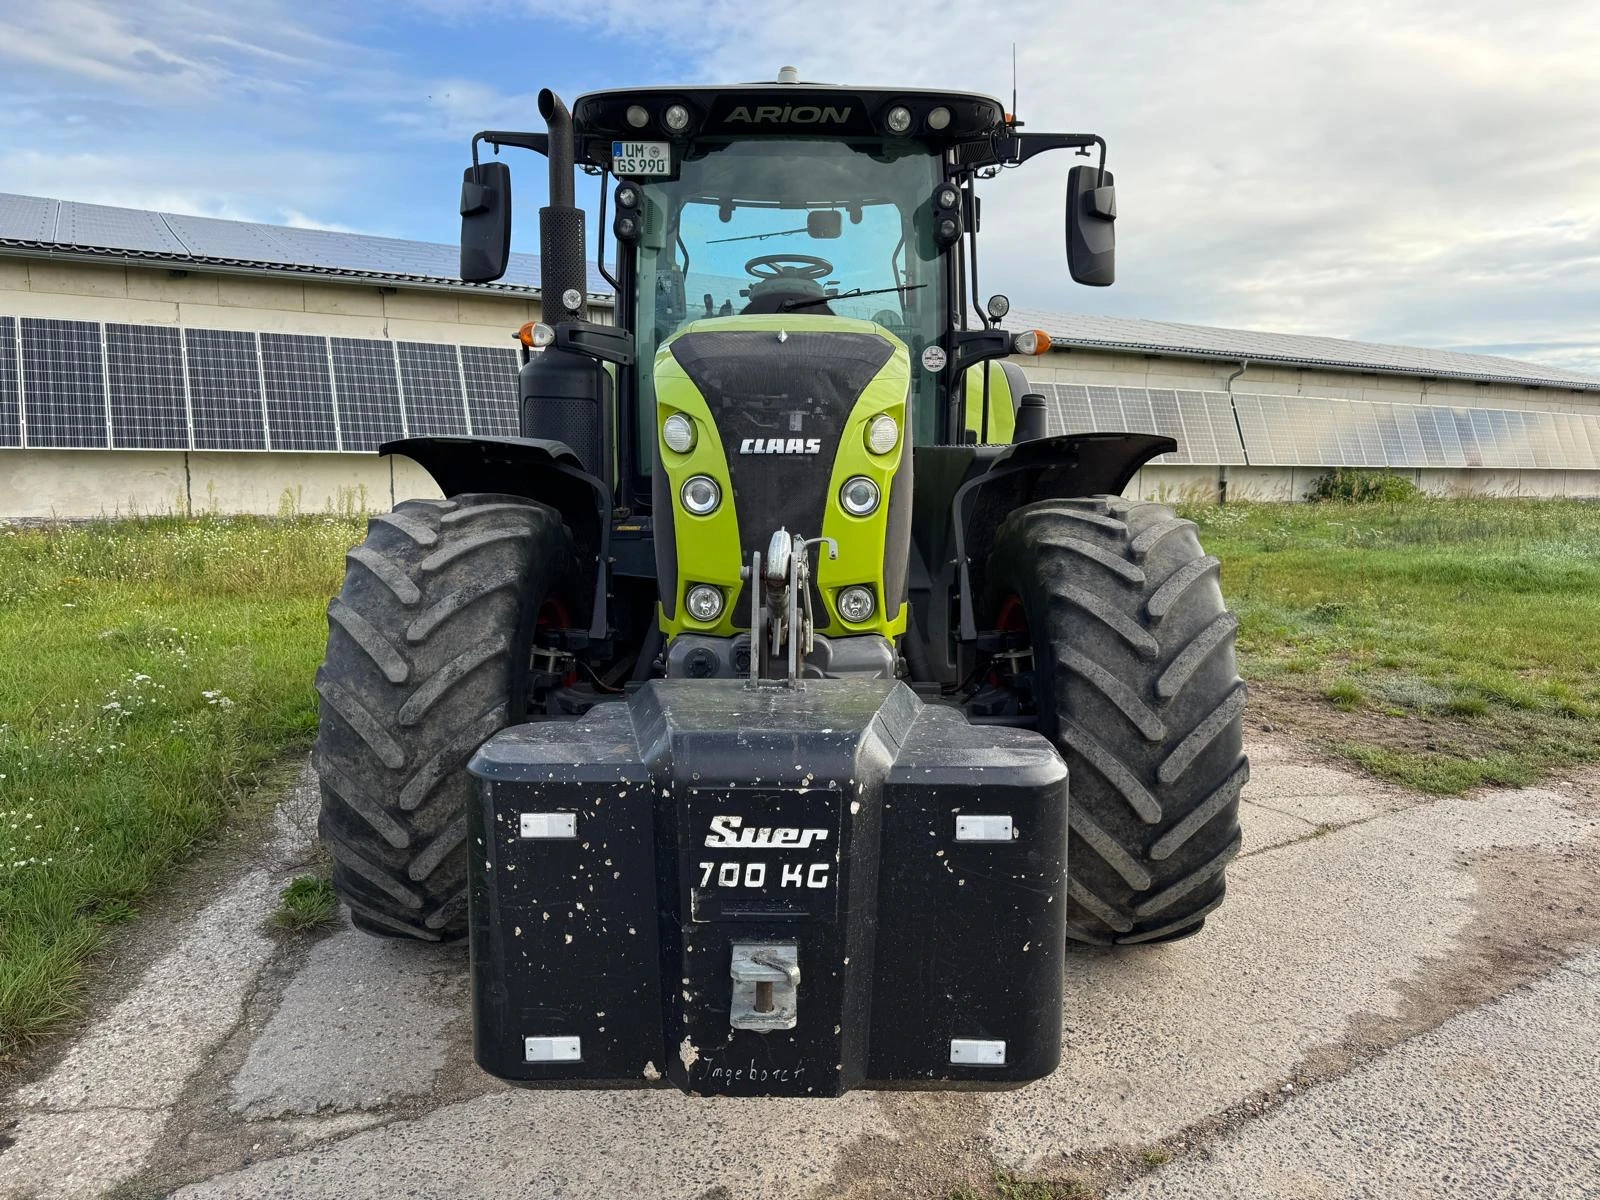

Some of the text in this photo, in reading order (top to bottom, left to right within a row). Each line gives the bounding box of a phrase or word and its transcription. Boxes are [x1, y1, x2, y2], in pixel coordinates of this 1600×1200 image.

[723, 102, 852, 124] ARION
[625, 143, 644, 158] UM
[617, 159, 665, 173] GS 990
[740, 438, 821, 454] CLAAS
[704, 815, 829, 849] Suer
[699, 862, 830, 889] 700 KG
